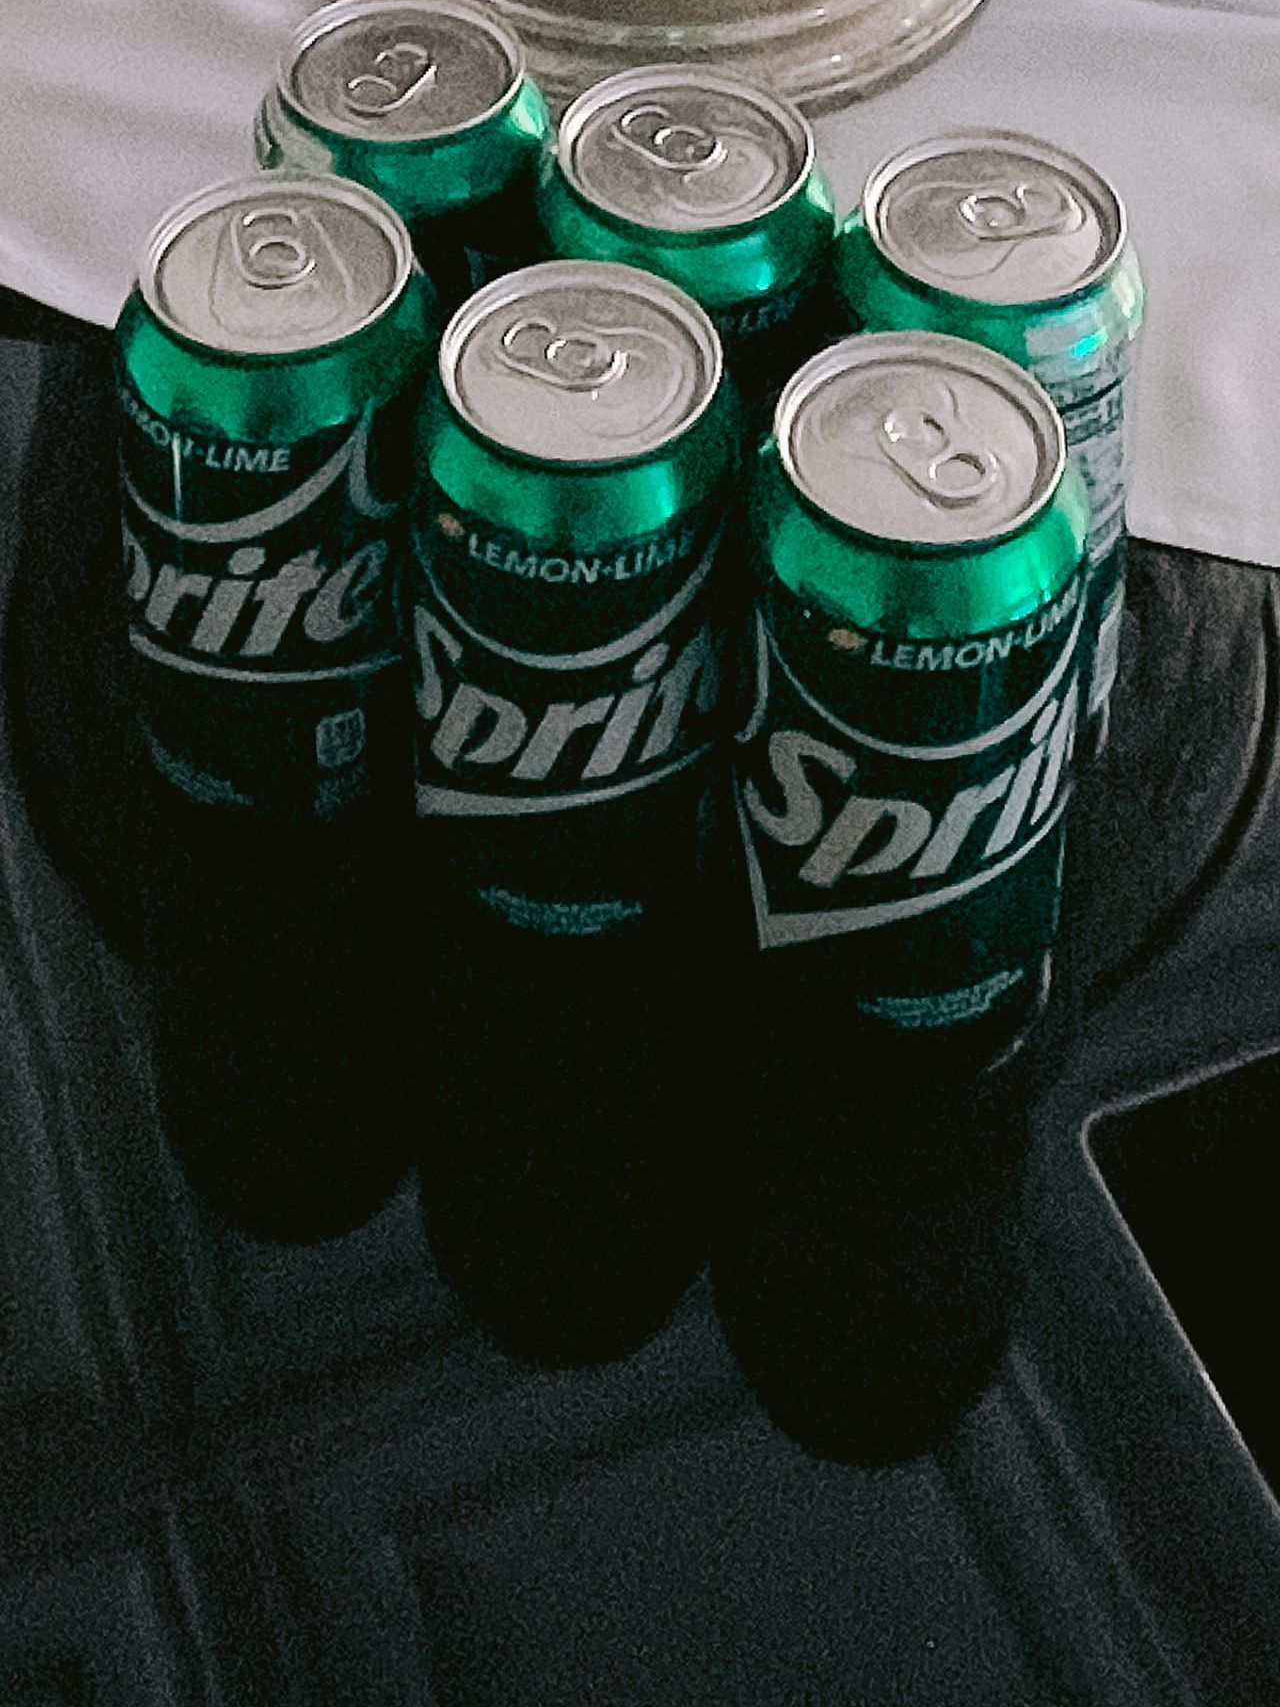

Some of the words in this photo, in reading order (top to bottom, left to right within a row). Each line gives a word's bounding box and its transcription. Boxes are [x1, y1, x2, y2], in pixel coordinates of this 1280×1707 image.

[412, 605, 720, 781] Sprit
[869, 579, 1078, 672] LEMON-LIM
[743, 672, 1078, 889] Sprit
